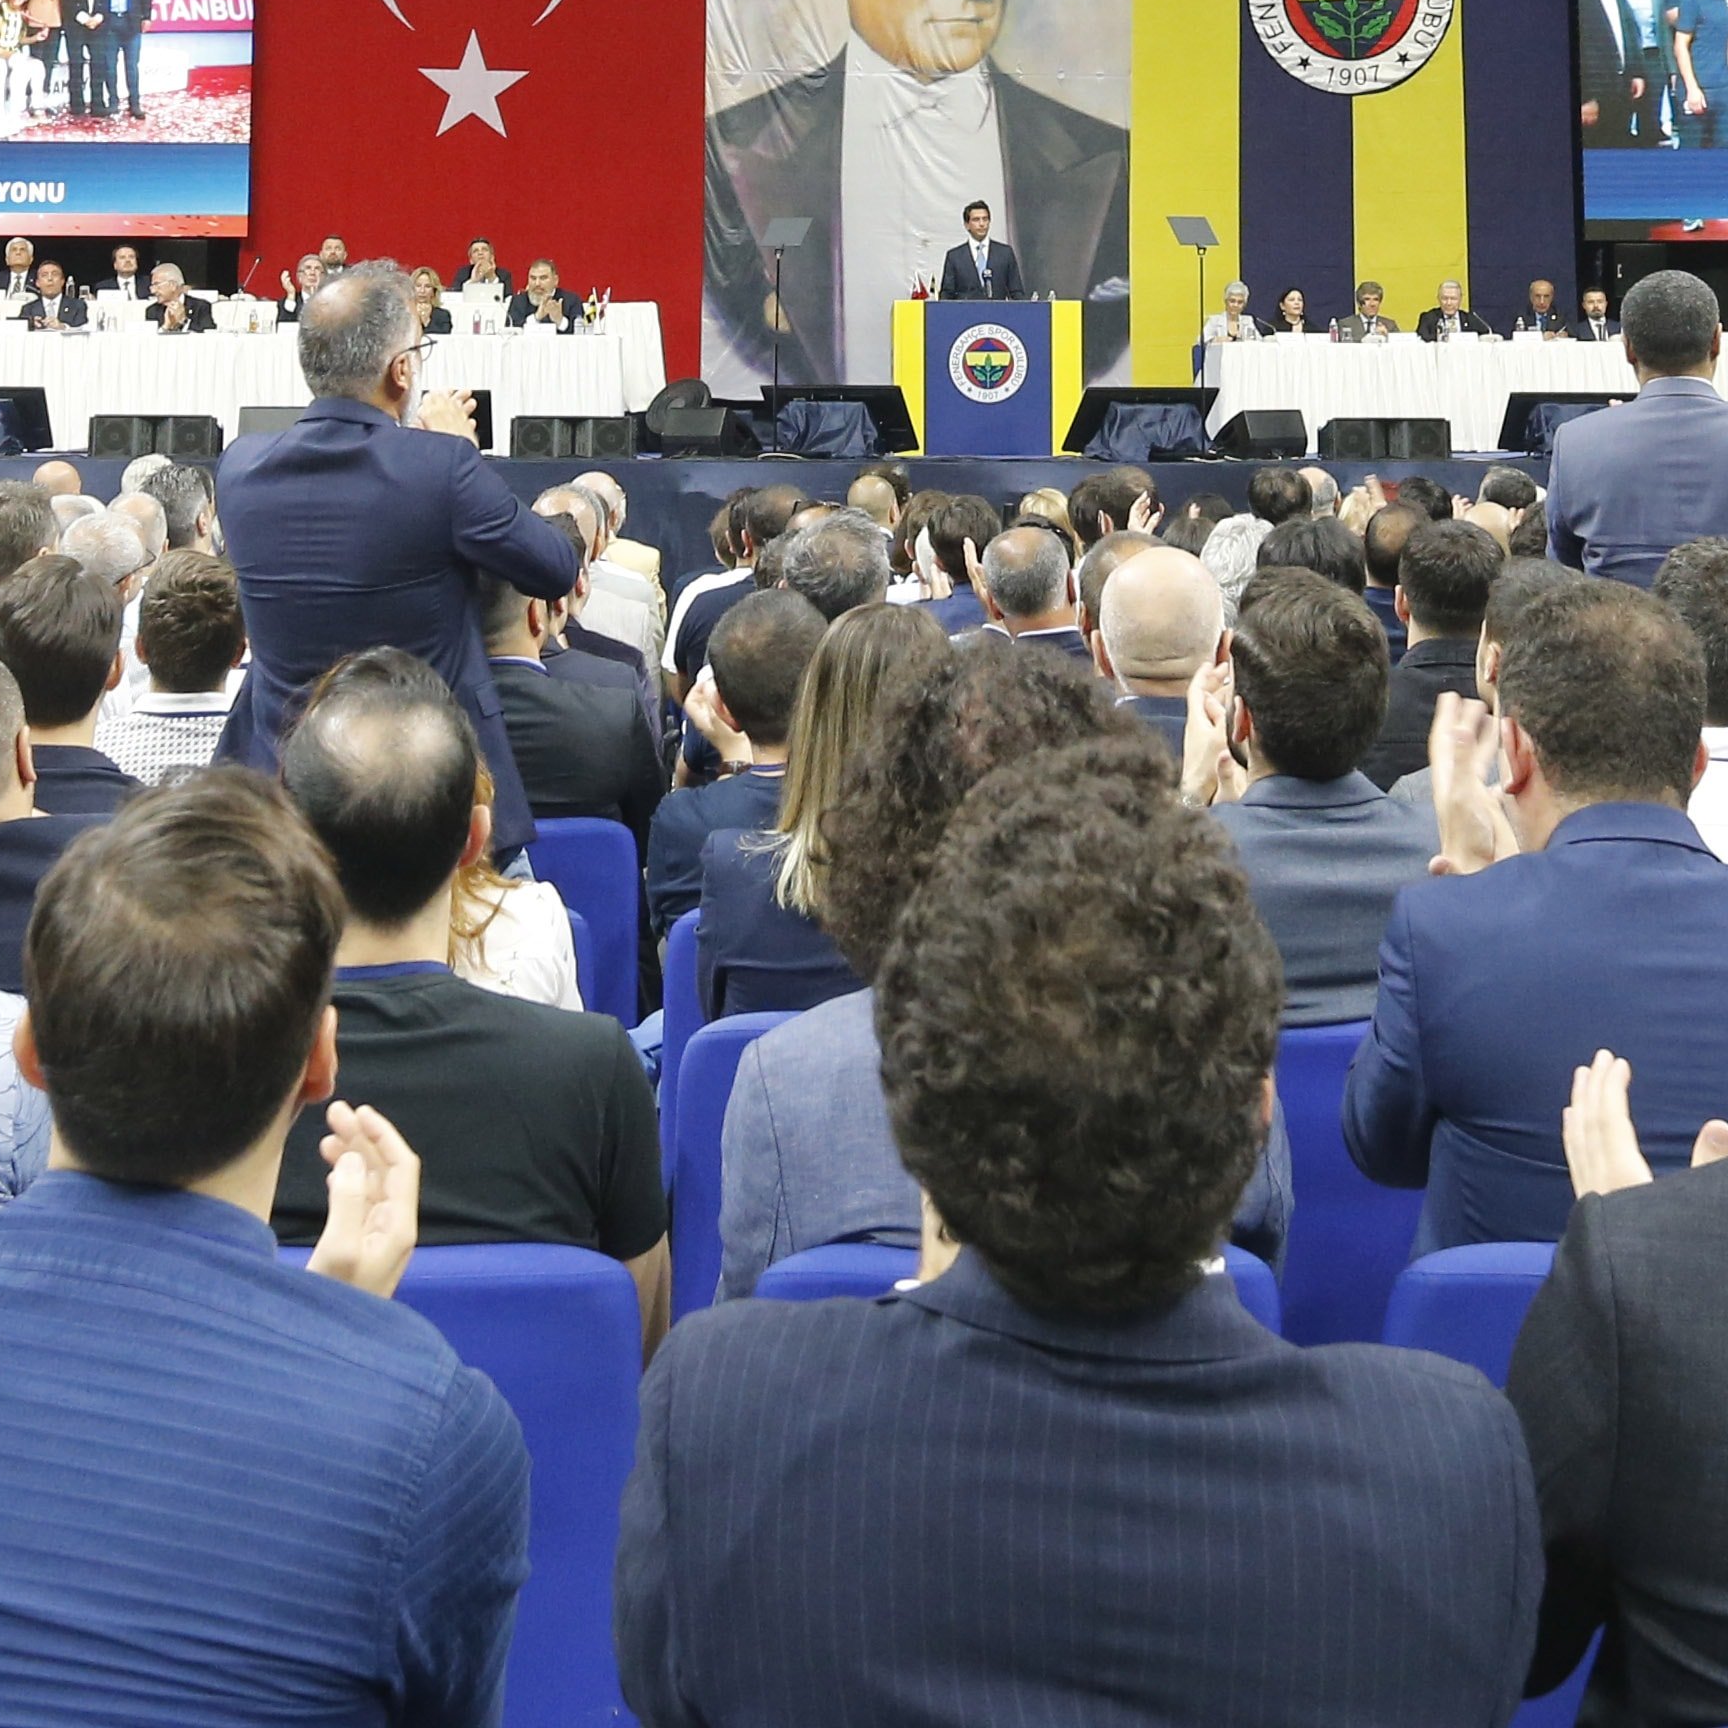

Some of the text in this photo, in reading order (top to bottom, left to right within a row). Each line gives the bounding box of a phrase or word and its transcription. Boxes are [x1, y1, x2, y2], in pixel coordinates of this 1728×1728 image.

[1326, 64, 1381, 87] 1907
[951, 326, 986, 388] FENERBAHÇE
[987, 326, 1016, 345] SPOR
[977, 390, 1000, 401] 1907
